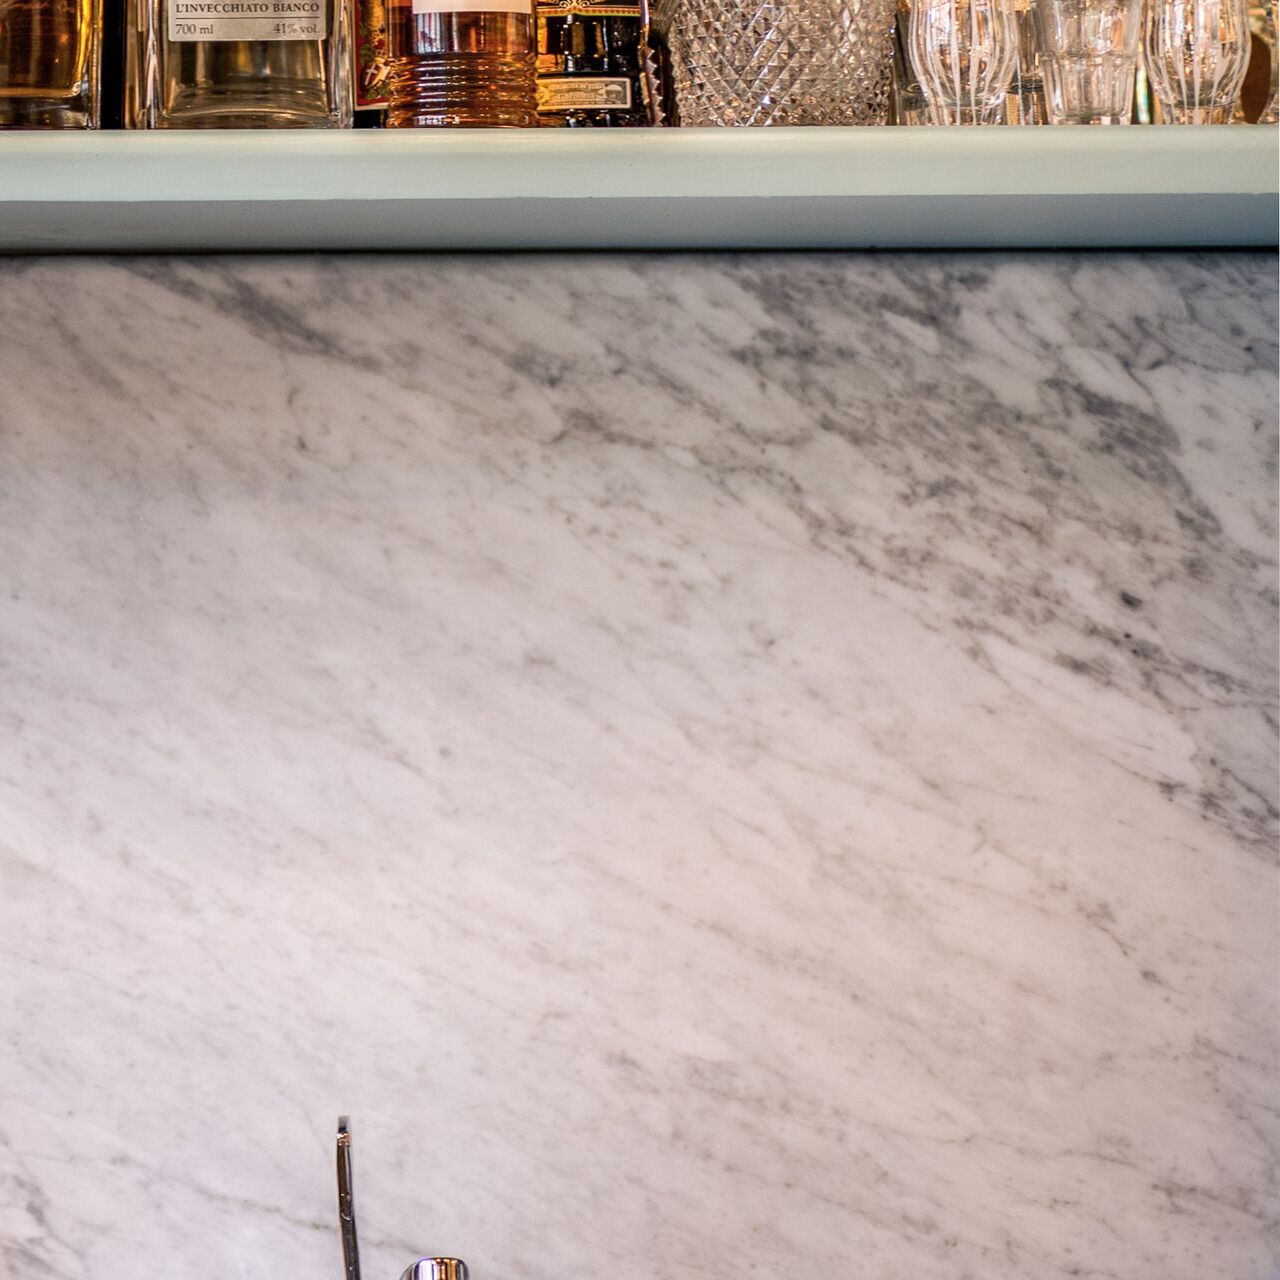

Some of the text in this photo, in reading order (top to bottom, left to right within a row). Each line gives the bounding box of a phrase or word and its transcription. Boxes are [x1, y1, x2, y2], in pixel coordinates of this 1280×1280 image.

[175, 2, 320, 14] L'INVECCHIATO BIANCO
[175, 23, 214, 35] 700 ml
[273, 23, 321, 35] 41% vol.
